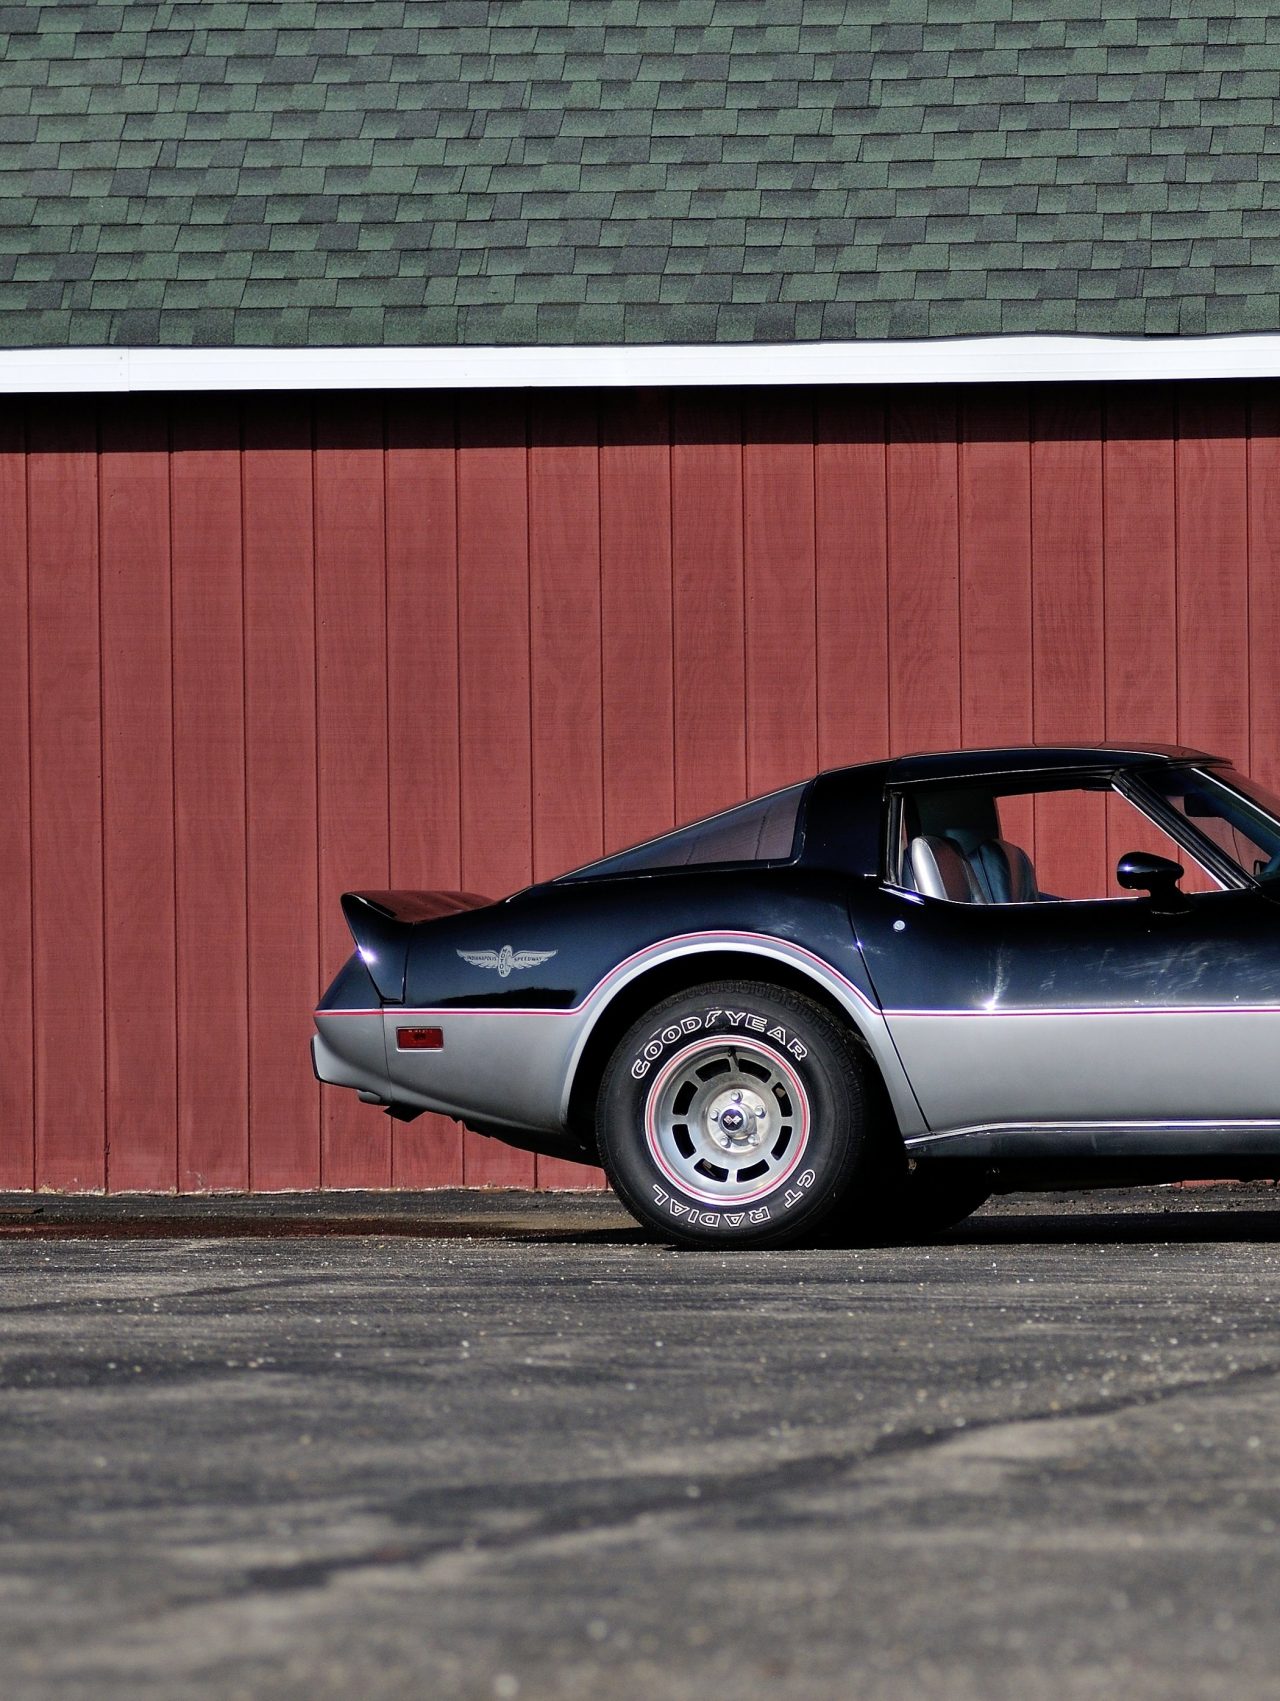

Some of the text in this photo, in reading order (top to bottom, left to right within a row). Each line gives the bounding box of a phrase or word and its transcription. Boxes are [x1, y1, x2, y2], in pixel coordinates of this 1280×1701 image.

[499, 948, 507, 975] MOTOR
[631, 1010, 808, 1080] GOODYEAR
[652, 1169, 816, 1227] GT RADIAL
